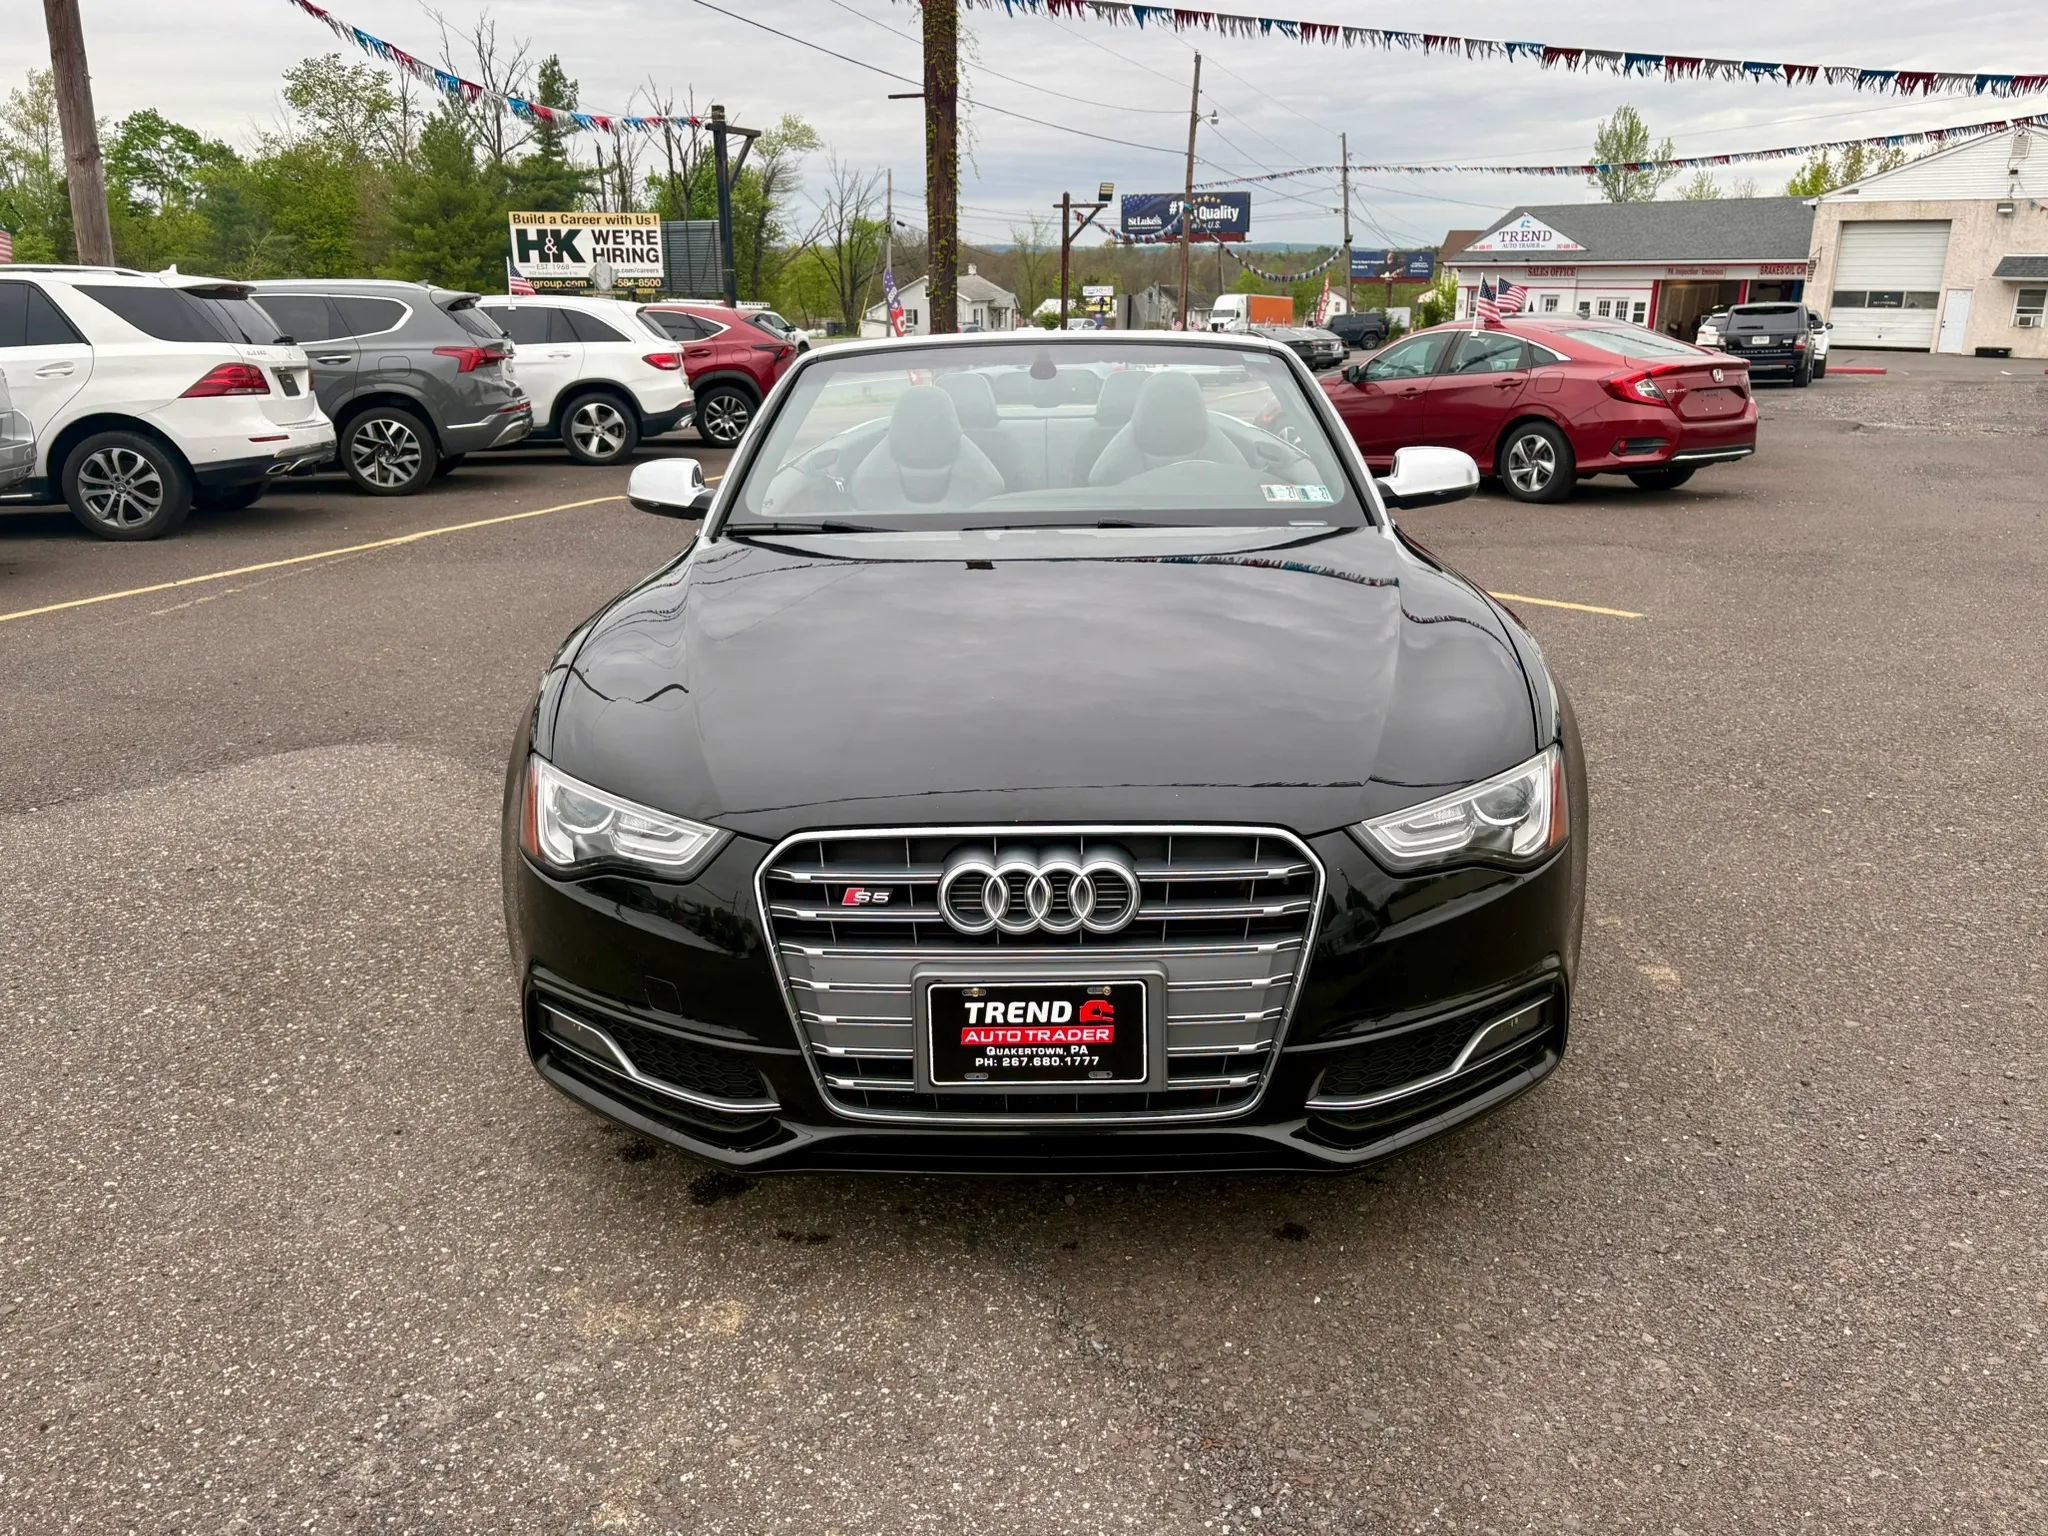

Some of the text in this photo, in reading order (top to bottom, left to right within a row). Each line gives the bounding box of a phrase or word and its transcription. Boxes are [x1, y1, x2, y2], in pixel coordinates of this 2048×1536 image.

[512, 213, 545, 225] Build
[549, 216, 557, 225] a
[560, 214, 600, 225] Career
[605, 214, 632, 225] with
[1199, 205, 1239, 222] Quality
[591, 229, 658, 246] WE'RE
[1499, 230, 1552, 243] TREND
[515, 228, 586, 263] H&K
[592, 247, 660, 263] HIRING
[552, 263, 570, 271] 1968
[1527, 267, 1576, 277] SALES OFFICE
[1760, 265, 1784, 275] BRAKES
[854, 891, 890, 903] S5
[964, 1001, 1073, 1024] TREND
[965, 1028, 1110, 1042] AUTO TRADER
[1070, 1045, 1089, 1055] PA
[975, 1056, 1100, 1067] PH: 267.680.1777
